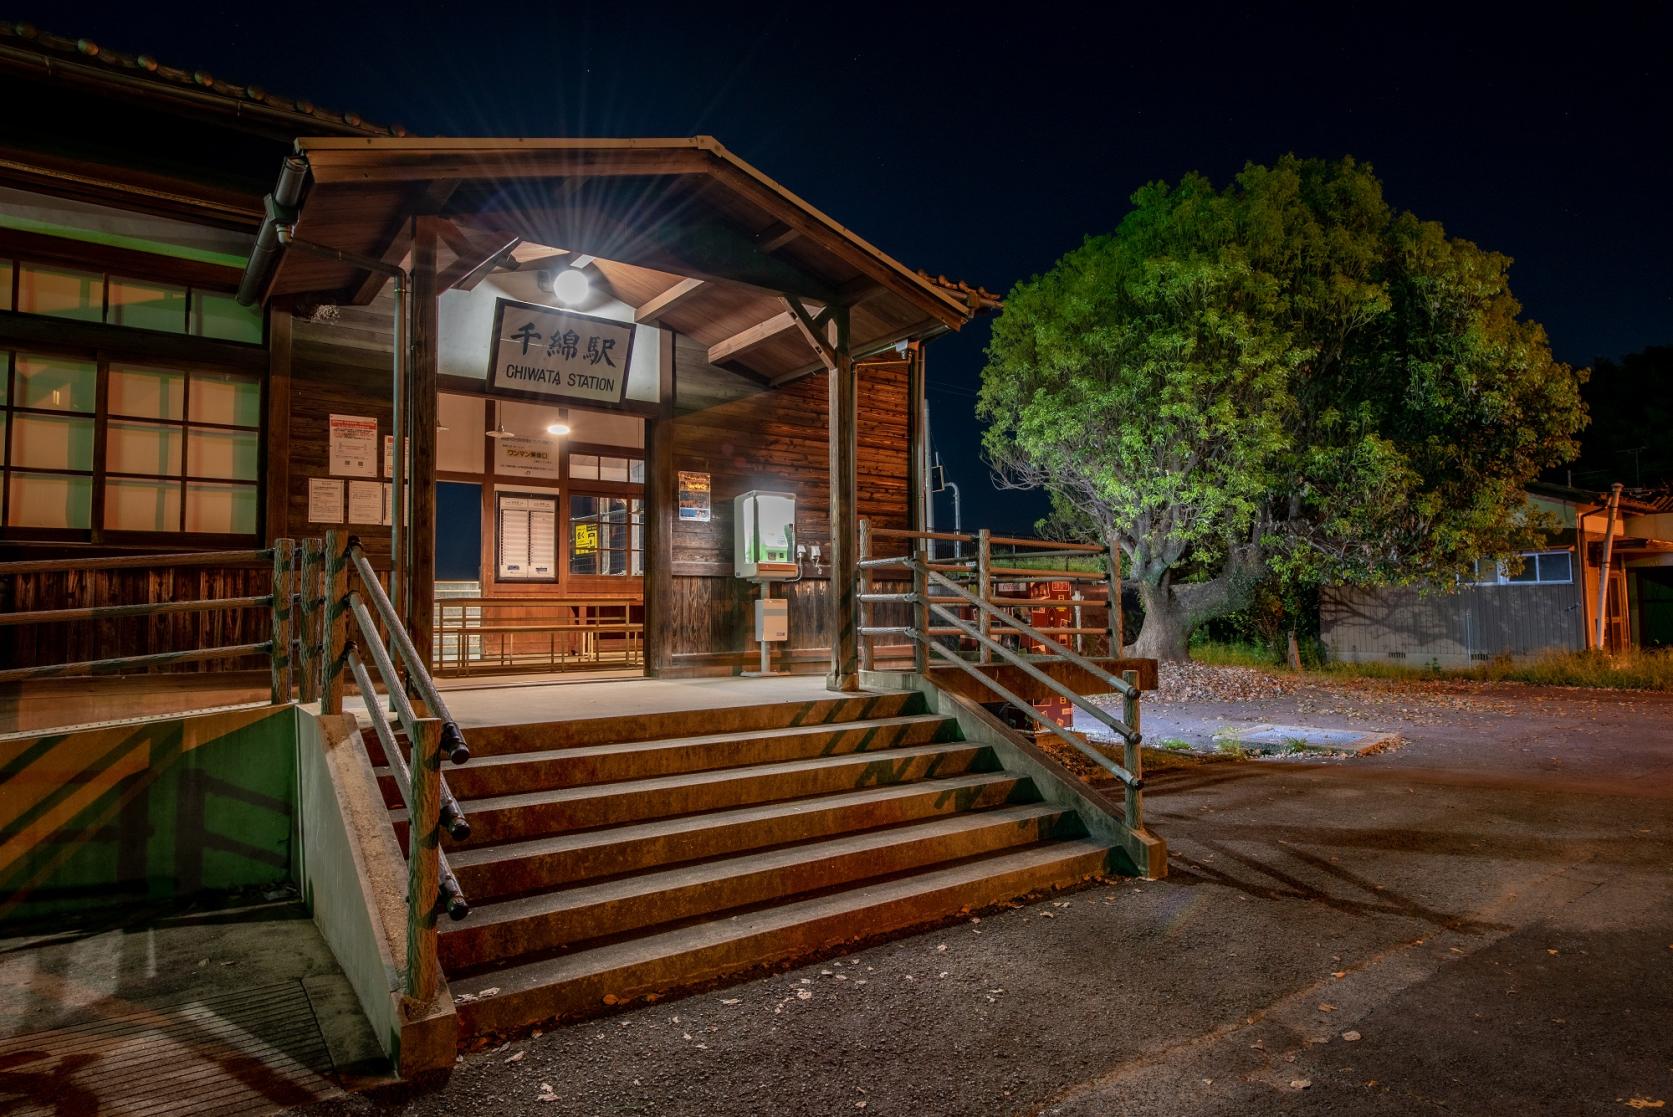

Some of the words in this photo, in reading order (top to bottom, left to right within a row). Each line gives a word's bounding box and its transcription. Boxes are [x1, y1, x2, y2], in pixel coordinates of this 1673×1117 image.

[511, 322, 616, 368] 千綿駅
[506, 364, 561, 386] CHIWATA
[567, 373, 615, 392] STATION
